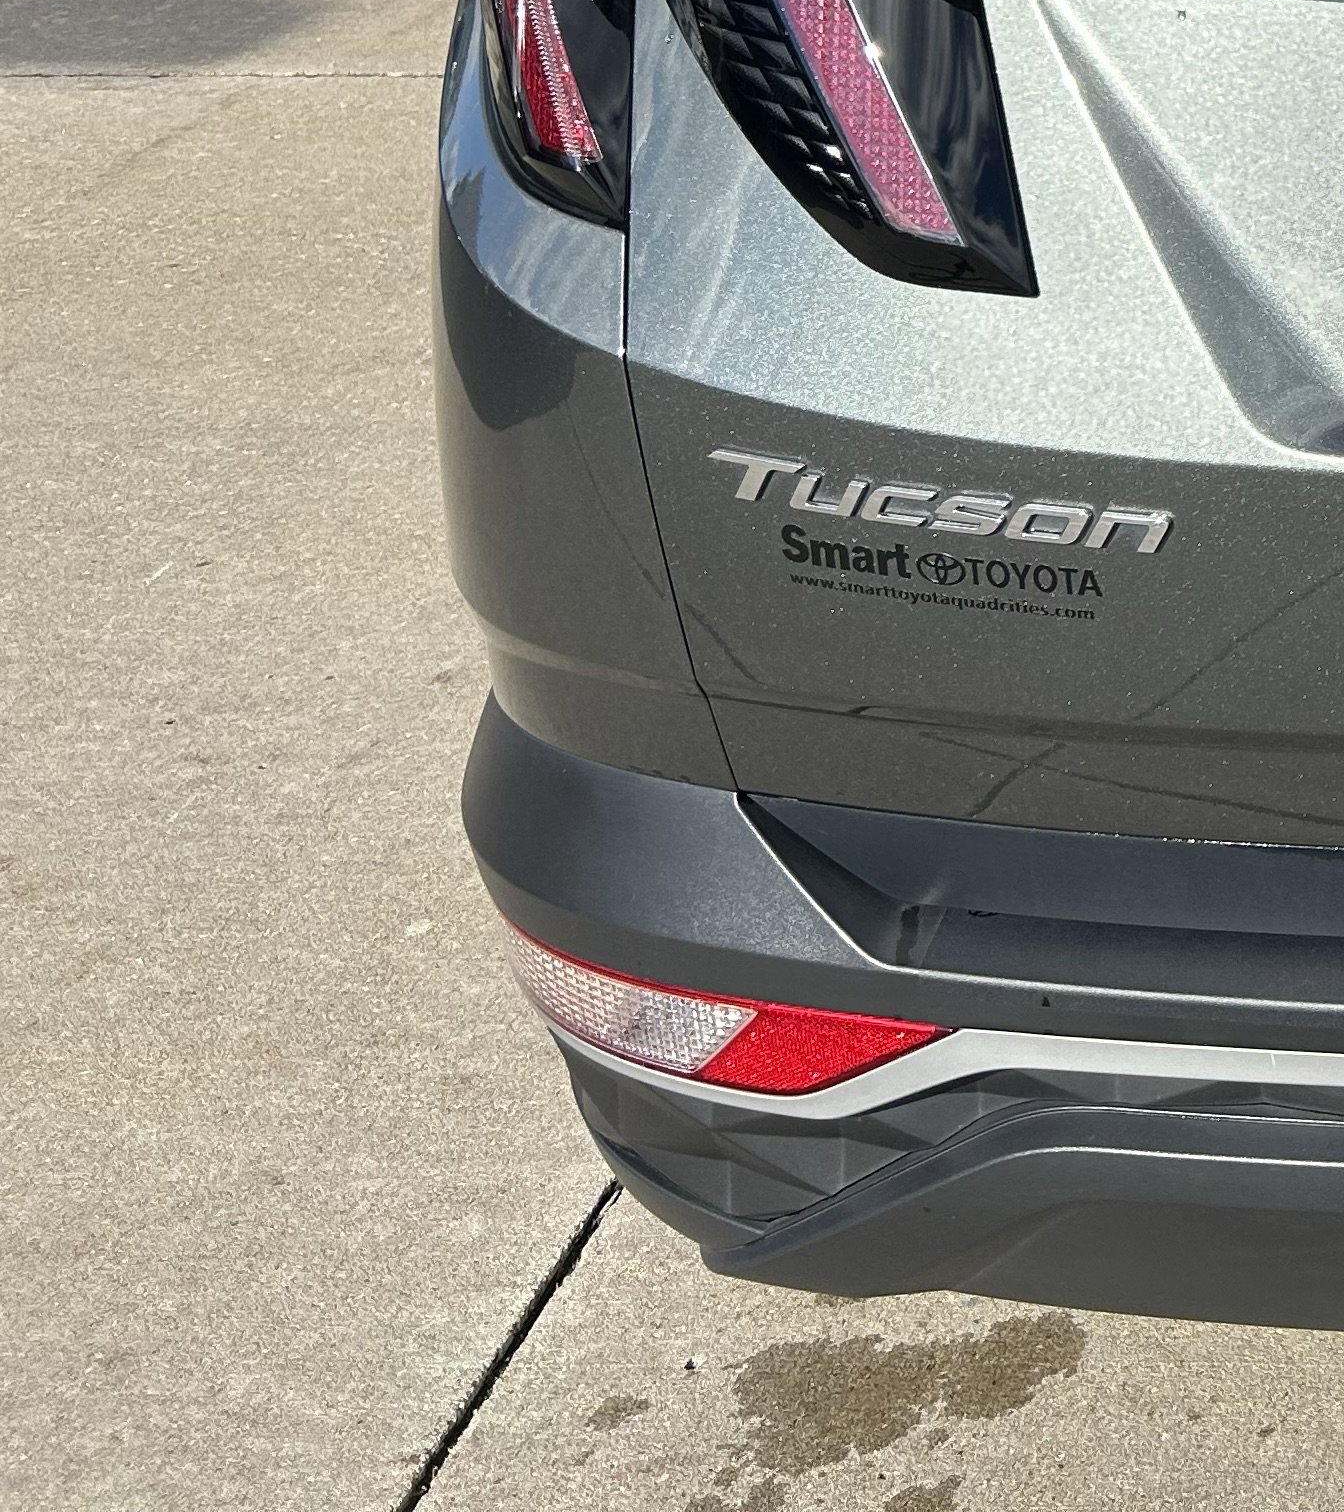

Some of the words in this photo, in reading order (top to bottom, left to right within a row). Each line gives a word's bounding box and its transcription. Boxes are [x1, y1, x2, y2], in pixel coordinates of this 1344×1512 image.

[780, 524, 912, 580] Smart
[964, 557, 1103, 598] TOYOTA
[789, 571, 1096, 620] www.smarttoyotaquadcities.com
